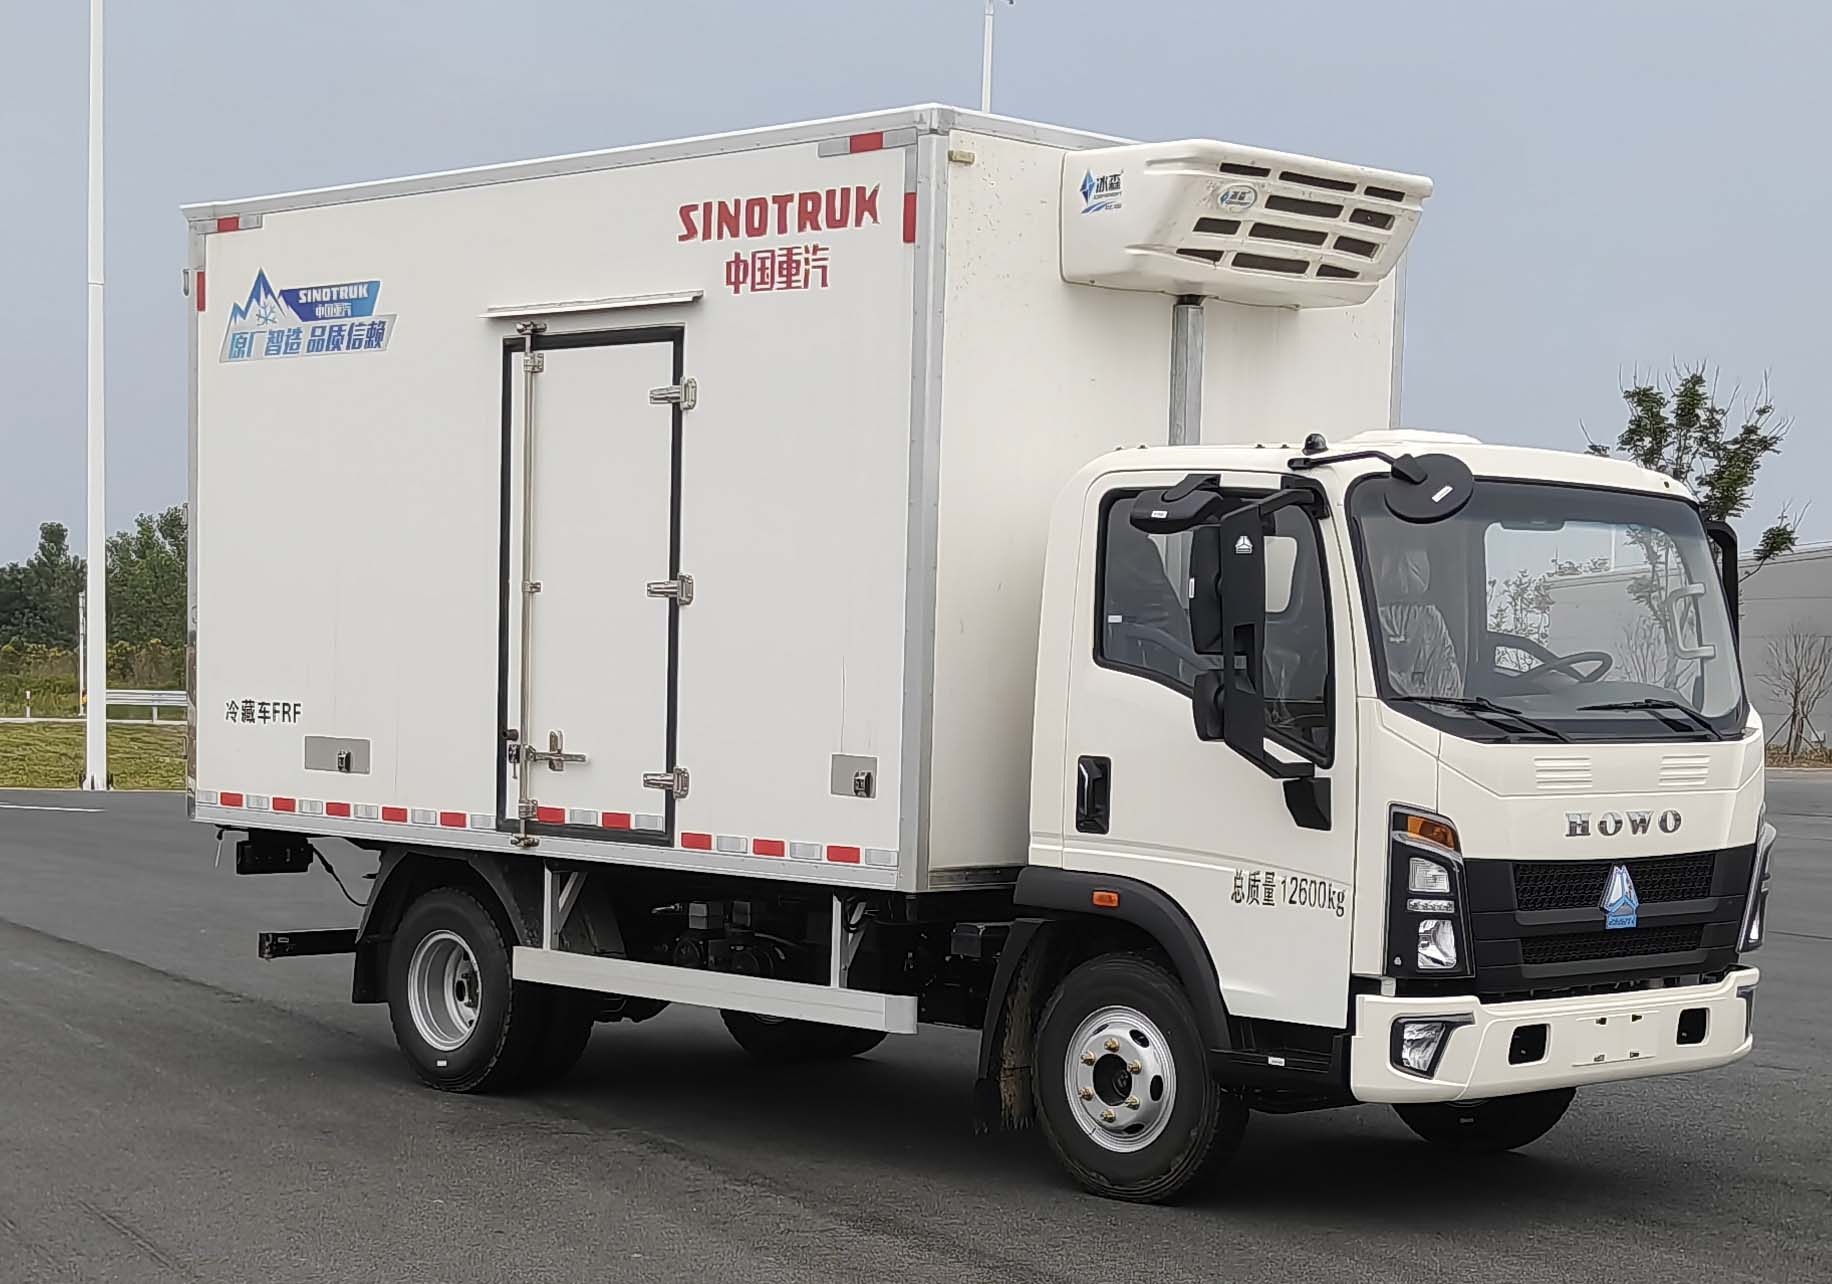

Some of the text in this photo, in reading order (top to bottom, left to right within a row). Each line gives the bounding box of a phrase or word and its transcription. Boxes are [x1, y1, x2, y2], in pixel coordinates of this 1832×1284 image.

[678, 183, 880, 241] SINOTRUK
[725, 243, 829, 294] 中国重汽
[298, 283, 369, 303] SINOTRUK
[228, 320, 388, 360] 原厂智造 品质信赖
[225, 699, 301, 724] 冷藏车FRF
[1565, 809, 1682, 837] HOWO
